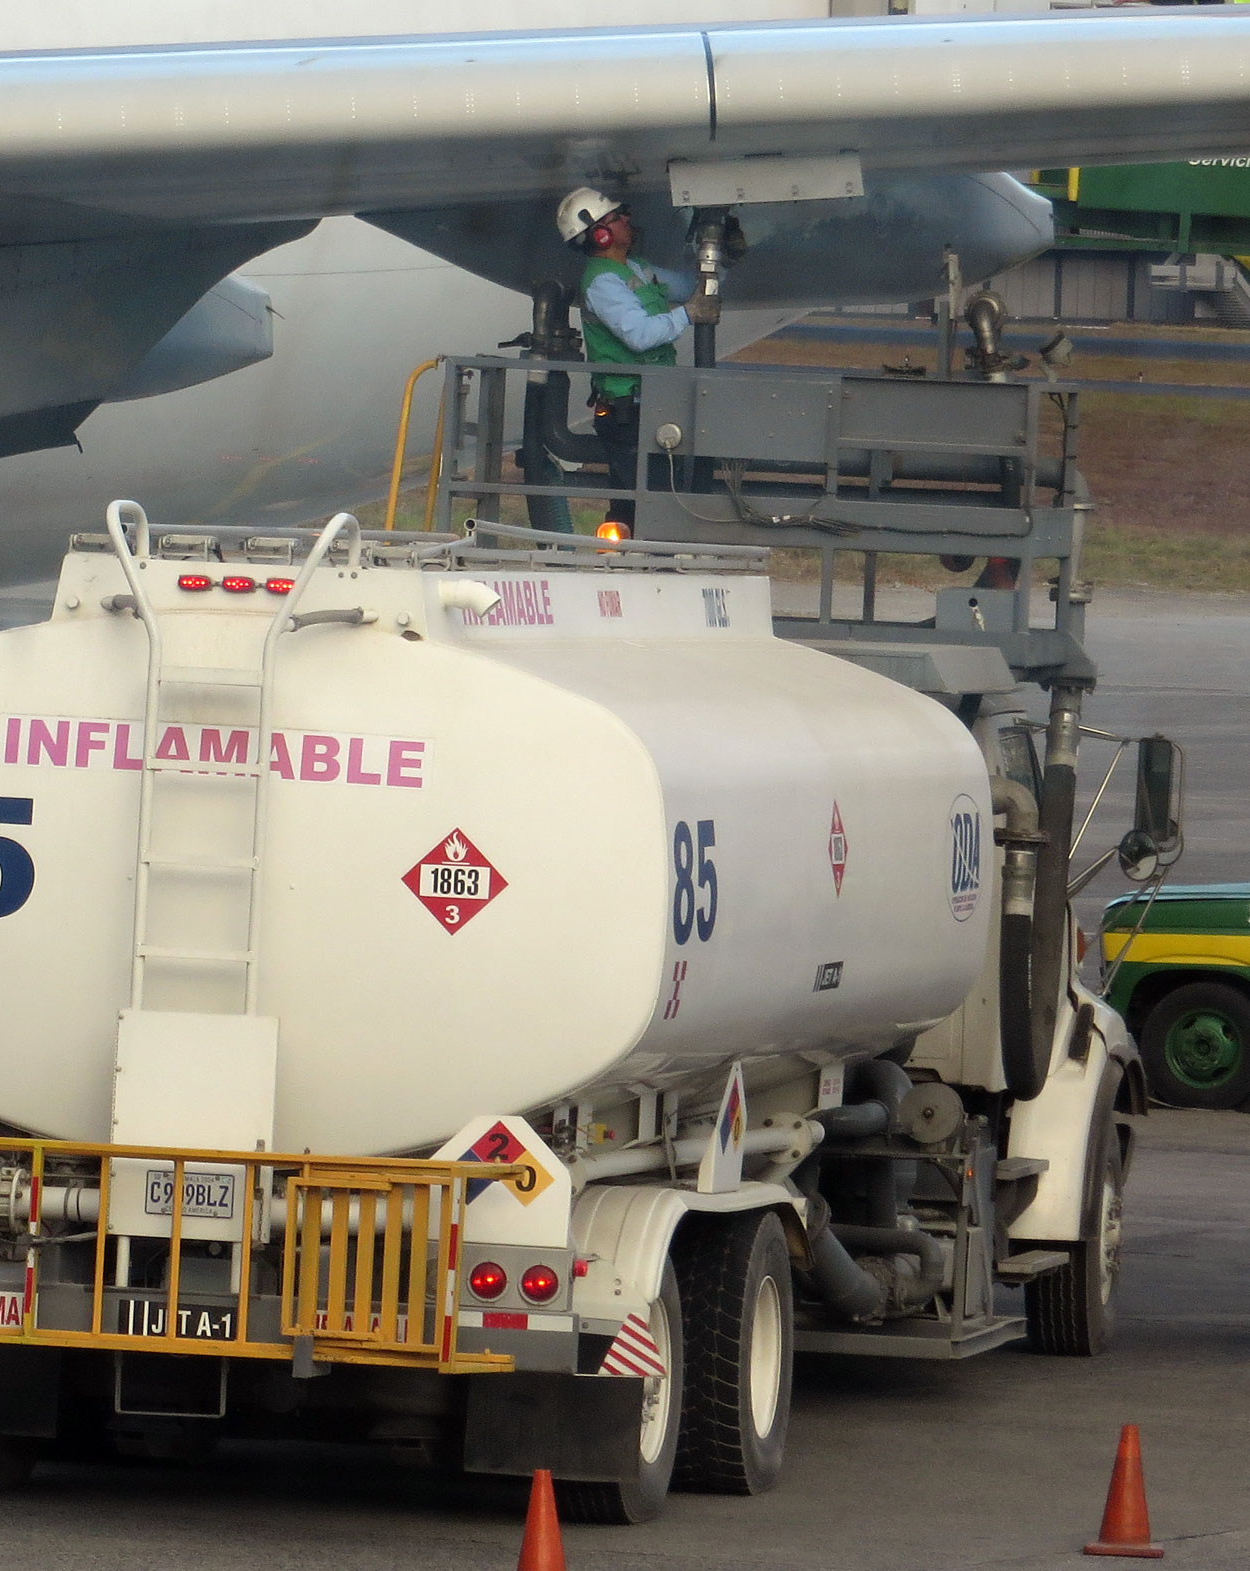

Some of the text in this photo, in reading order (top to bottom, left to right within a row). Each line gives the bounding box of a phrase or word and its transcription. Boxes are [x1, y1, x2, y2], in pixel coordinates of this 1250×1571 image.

[462, 580, 554, 626] AMABLE
[3, 716, 426, 790] INFLAMABLE
[430, 867, 480, 897] 1863
[672, 819, 719, 946] 85
[444, 904, 461, 925] 3
[487, 1132, 510, 1162] 2
[150, 1181, 229, 1207] C99BLZ
[514, 1165, 538, 1193] 0
[151, 1308, 232, 1338] JT A-1
